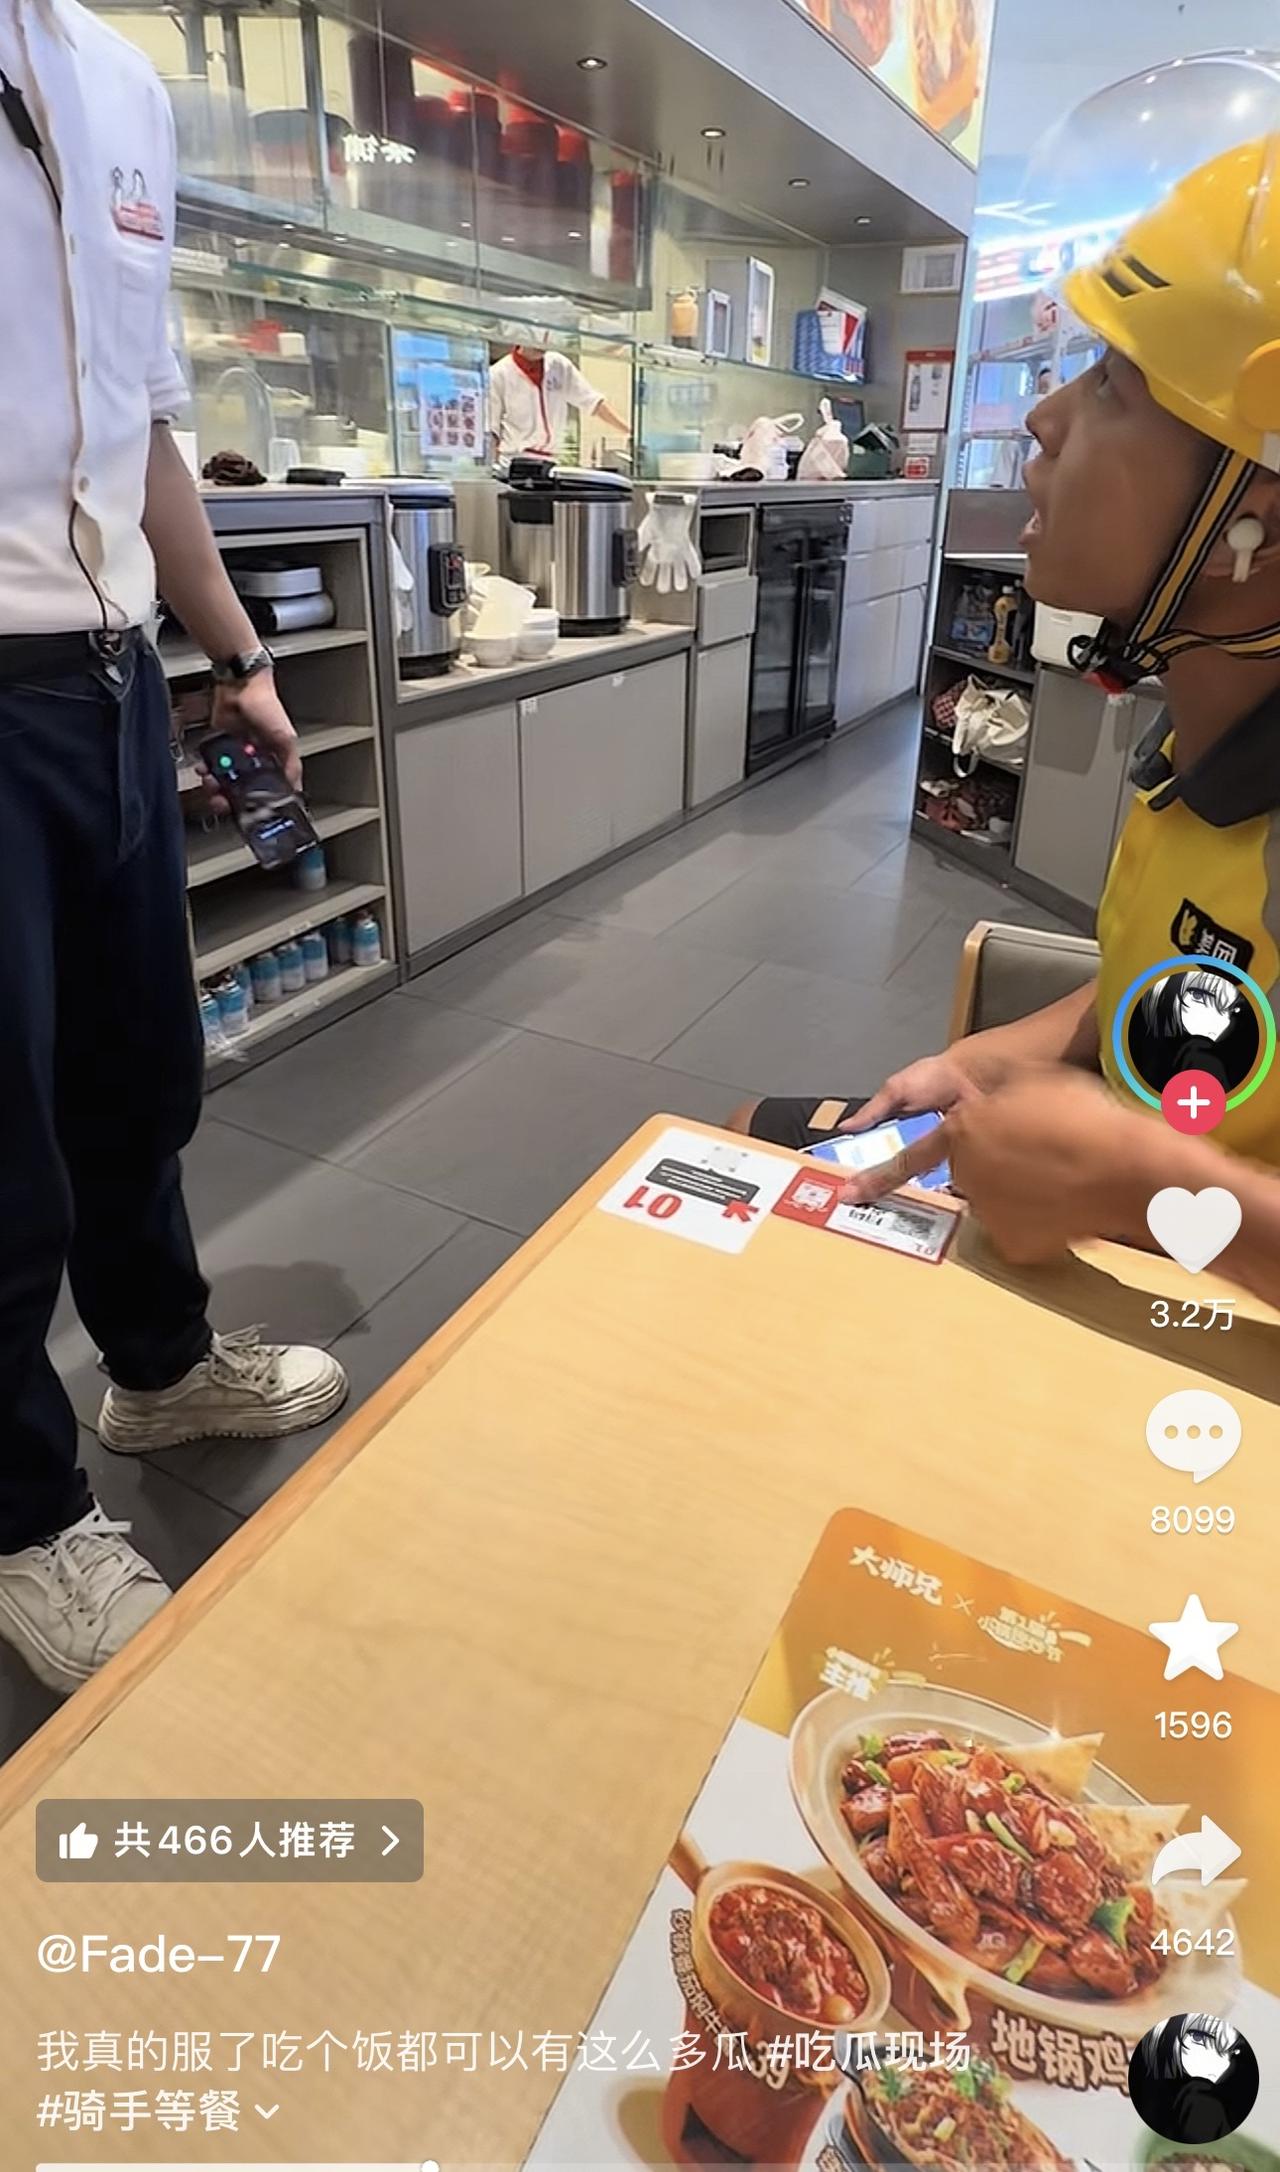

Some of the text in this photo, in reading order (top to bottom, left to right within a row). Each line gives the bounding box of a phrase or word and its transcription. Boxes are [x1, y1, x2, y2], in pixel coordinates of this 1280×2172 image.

[623, 1185, 683, 1218] 01
[849, 1545, 943, 1606] 大师兄
[990, 2008, 1131, 2097] 地锅鸡
